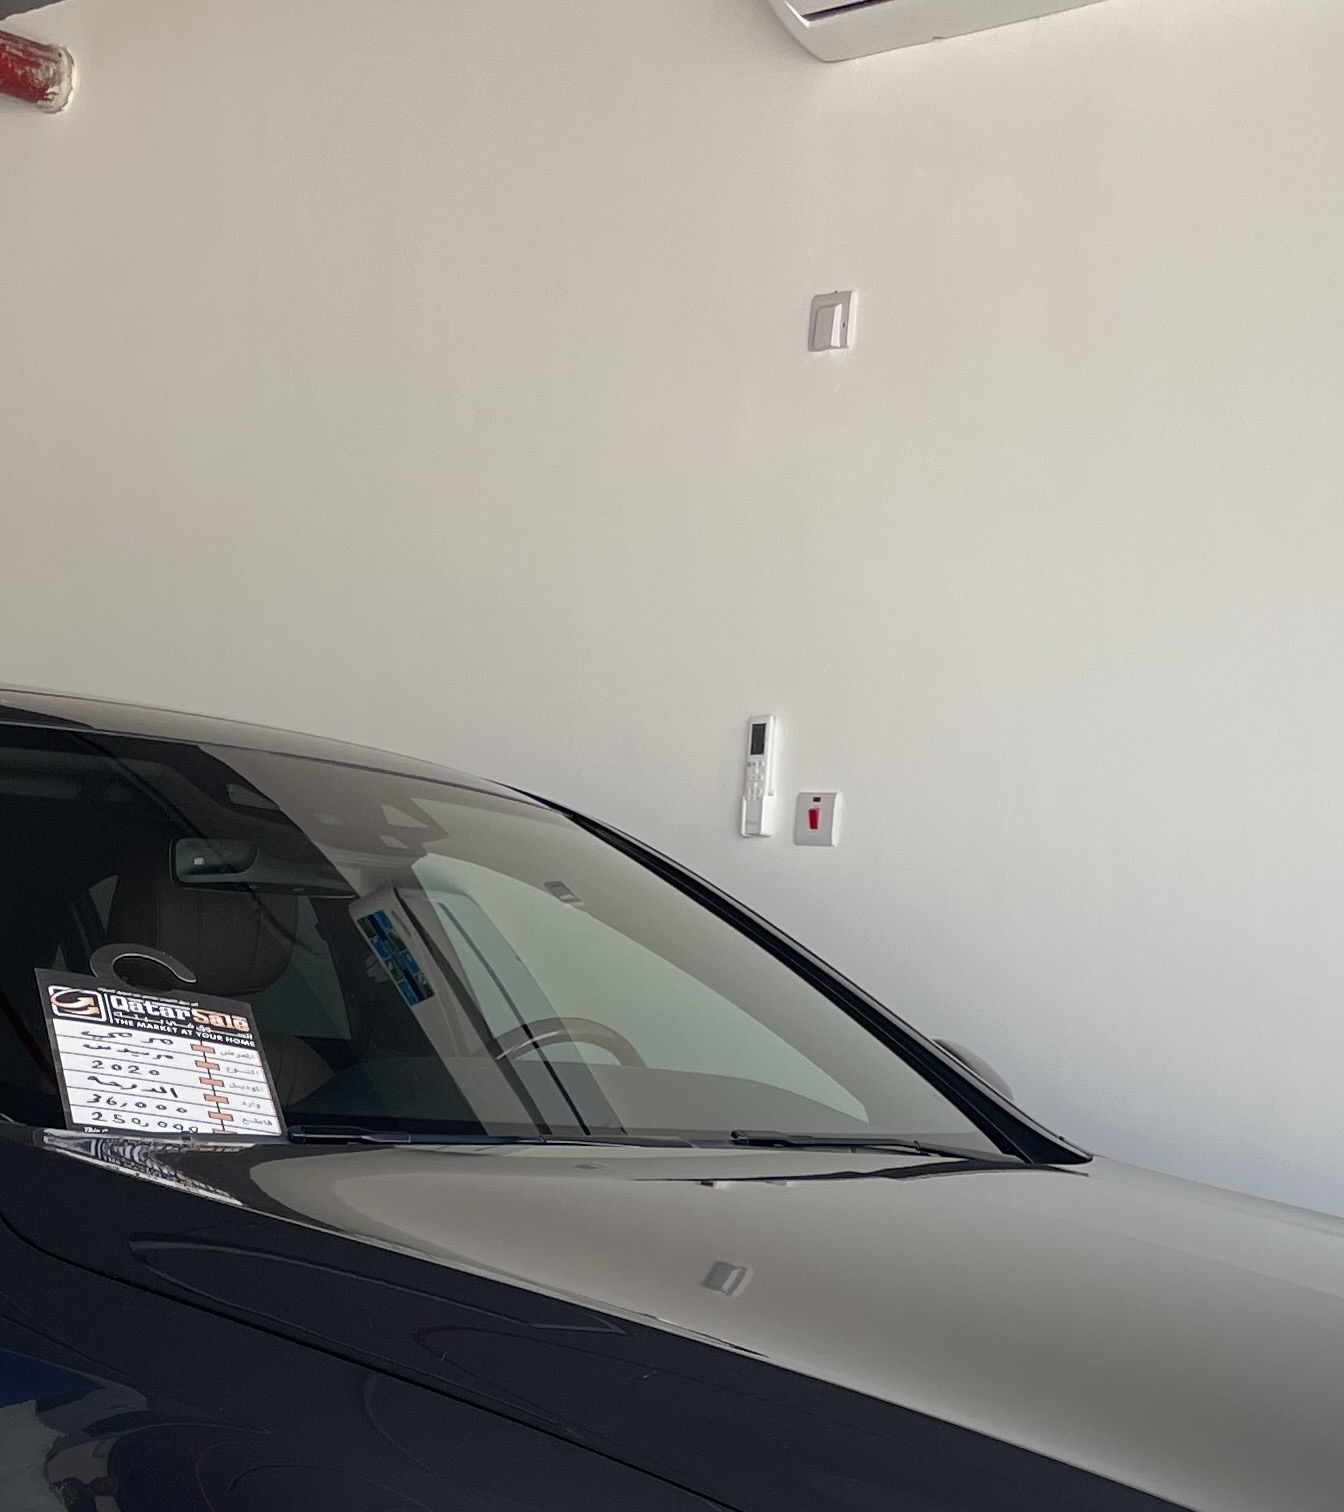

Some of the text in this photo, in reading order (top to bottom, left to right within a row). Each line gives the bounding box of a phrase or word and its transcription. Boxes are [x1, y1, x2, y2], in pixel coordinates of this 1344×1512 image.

[115, 1018, 256, 1048] THE MARKET AT YOUR HOME
[91, 1060, 160, 1076] 2020
[86, 1093, 188, 1113] 36,000
